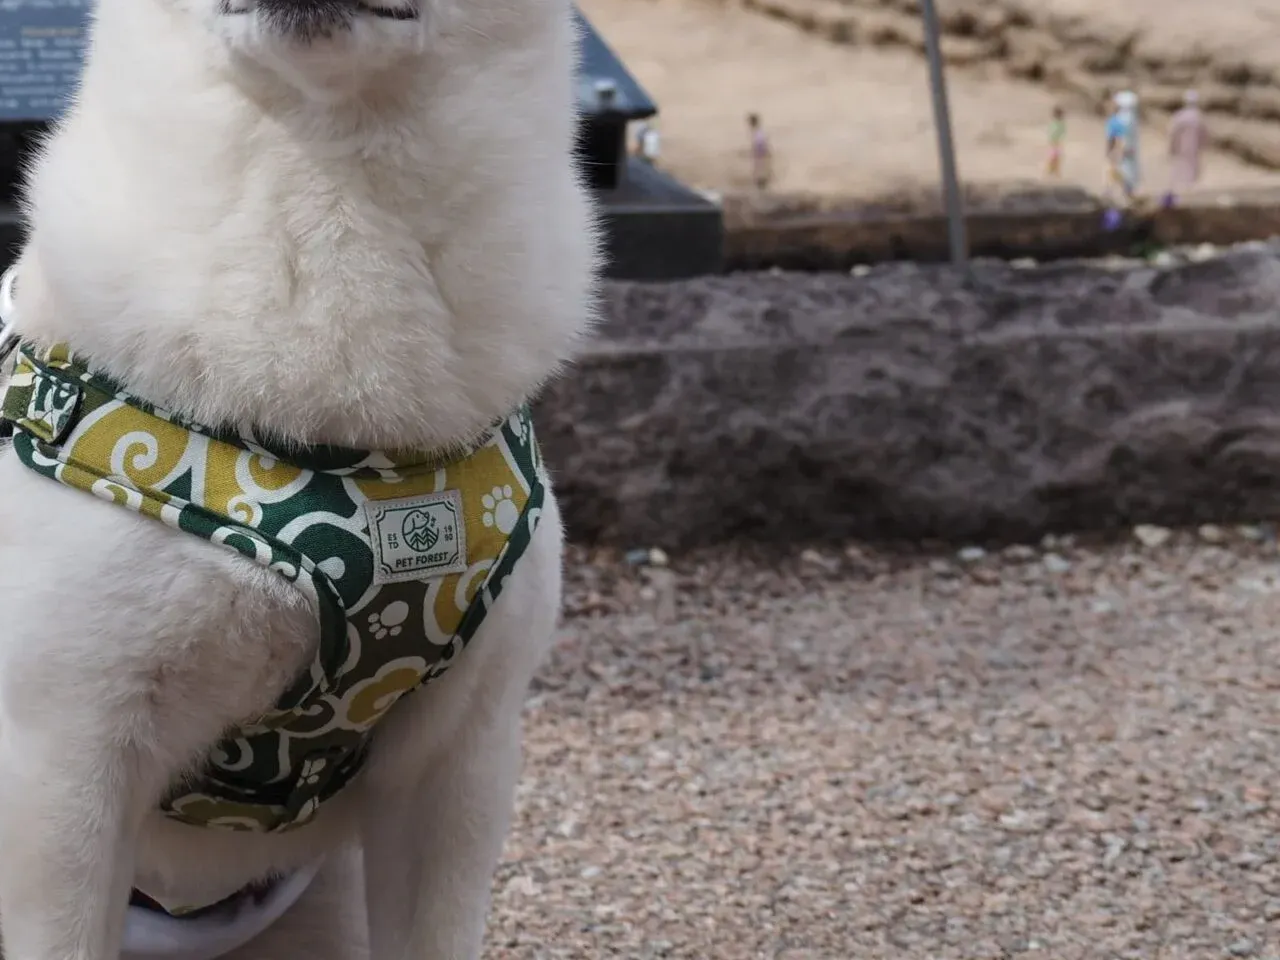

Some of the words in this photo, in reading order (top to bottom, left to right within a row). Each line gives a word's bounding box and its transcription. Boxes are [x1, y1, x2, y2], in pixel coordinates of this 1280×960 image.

[387, 533, 397, 541] ES
[388, 541, 399, 549] TD
[396, 557, 413, 568] PET
[416, 552, 448, 565] FOREST
